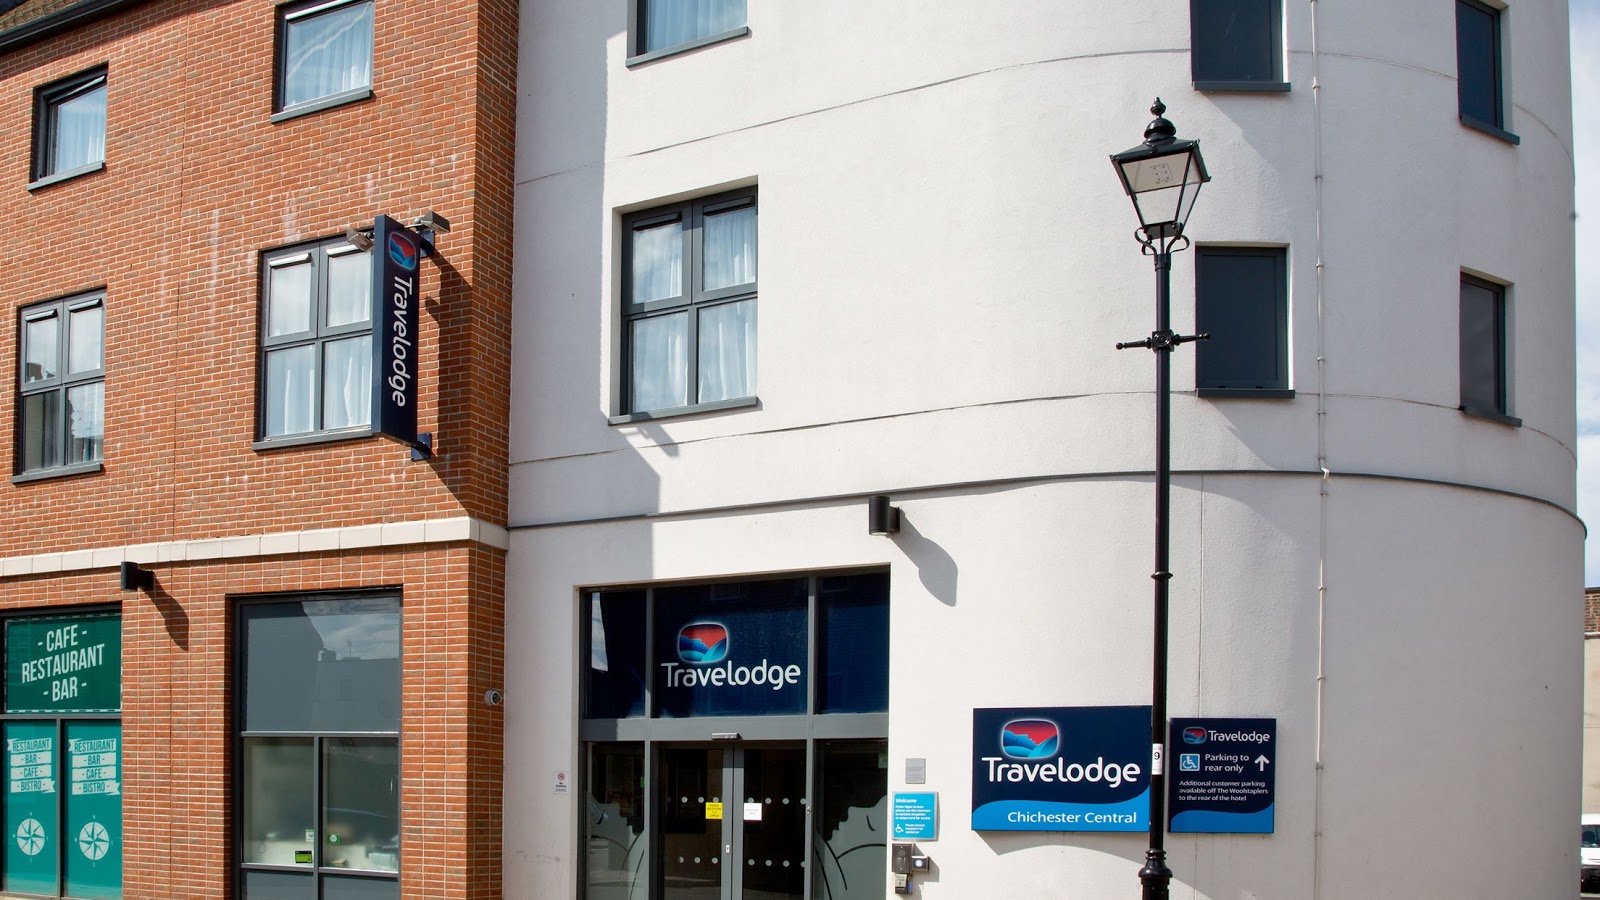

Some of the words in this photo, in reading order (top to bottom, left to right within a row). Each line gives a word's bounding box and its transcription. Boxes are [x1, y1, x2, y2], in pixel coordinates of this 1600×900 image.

[388, 275, 413, 407] Travelodge
[46, 624, 78, 652] CAFE
[22, 643, 105, 683] RESTAURANT
[661, 658, 801, 691] Travelodge
[52, 676, 78, 702] BAR
[1208, 730, 1270, 744] Travelodge
[12, 739, 50, 752] RESTAURANT
[74, 740, 114, 753] RESTAURANT
[25, 754, 38, 764] BAR
[87, 755, 101, 765] BAR
[1154, 751, 1160, 760] 9
[1205, 753, 1239, 763] Parking
[23, 767, 39, 777] CAFE
[86, 768, 102, 779] CAFE
[981, 756, 1141, 788] Travelodge
[1224, 764, 1244, 774] only
[21, 780, 41, 791] BISTRO
[83, 782, 105, 793] BISTRO
[1241, 780, 1266, 788] parking
[1007, 811, 1081, 823] Chichester
[1084, 811, 1137, 823] Central
